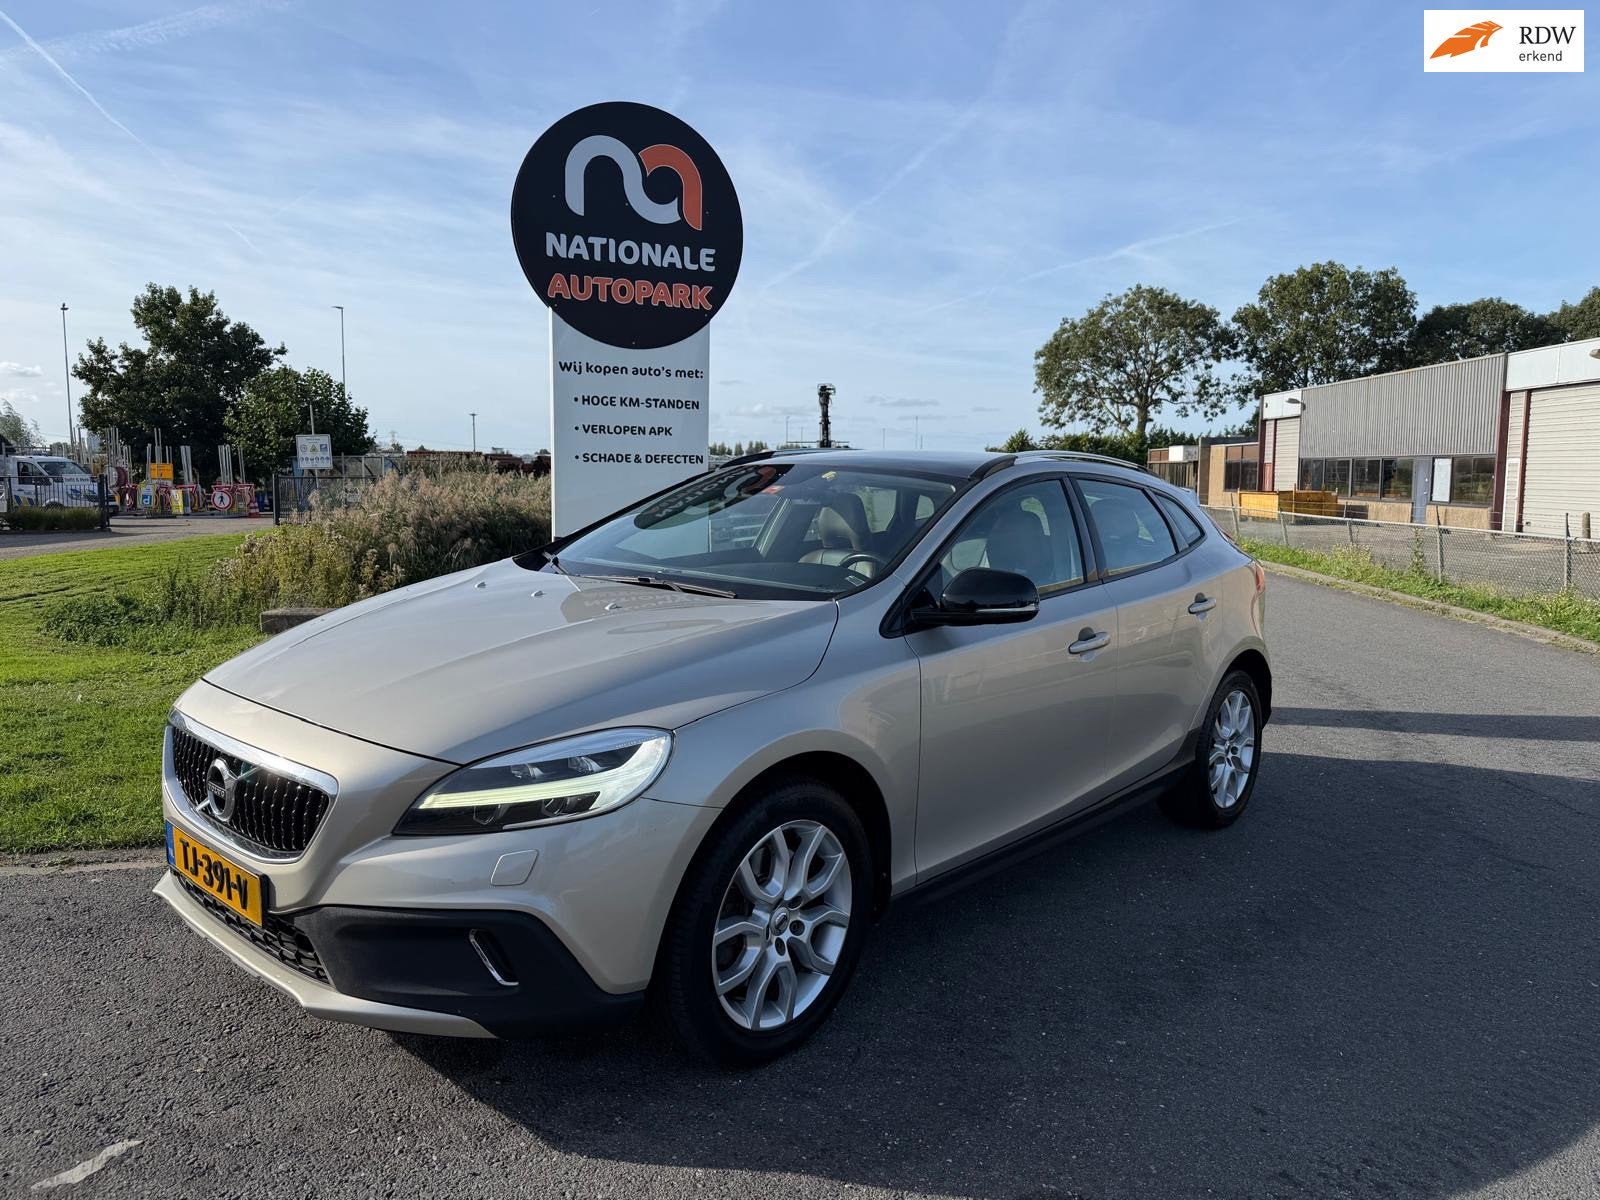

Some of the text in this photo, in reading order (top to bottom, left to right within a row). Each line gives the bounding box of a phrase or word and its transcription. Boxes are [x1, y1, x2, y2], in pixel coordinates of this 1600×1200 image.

[545, 231, 716, 272] NATIONALE
[547, 272, 713, 311] AUTOPARK
[558, 361, 704, 379] Wij kopen auto's met:
[582, 395, 700, 410] HOGE KM-STANDEN
[582, 424, 673, 436] VERLOPEN APK
[582, 452, 704, 464] SCHADE & DEFECTEN
[179, 838, 249, 912] TJ-391-V
